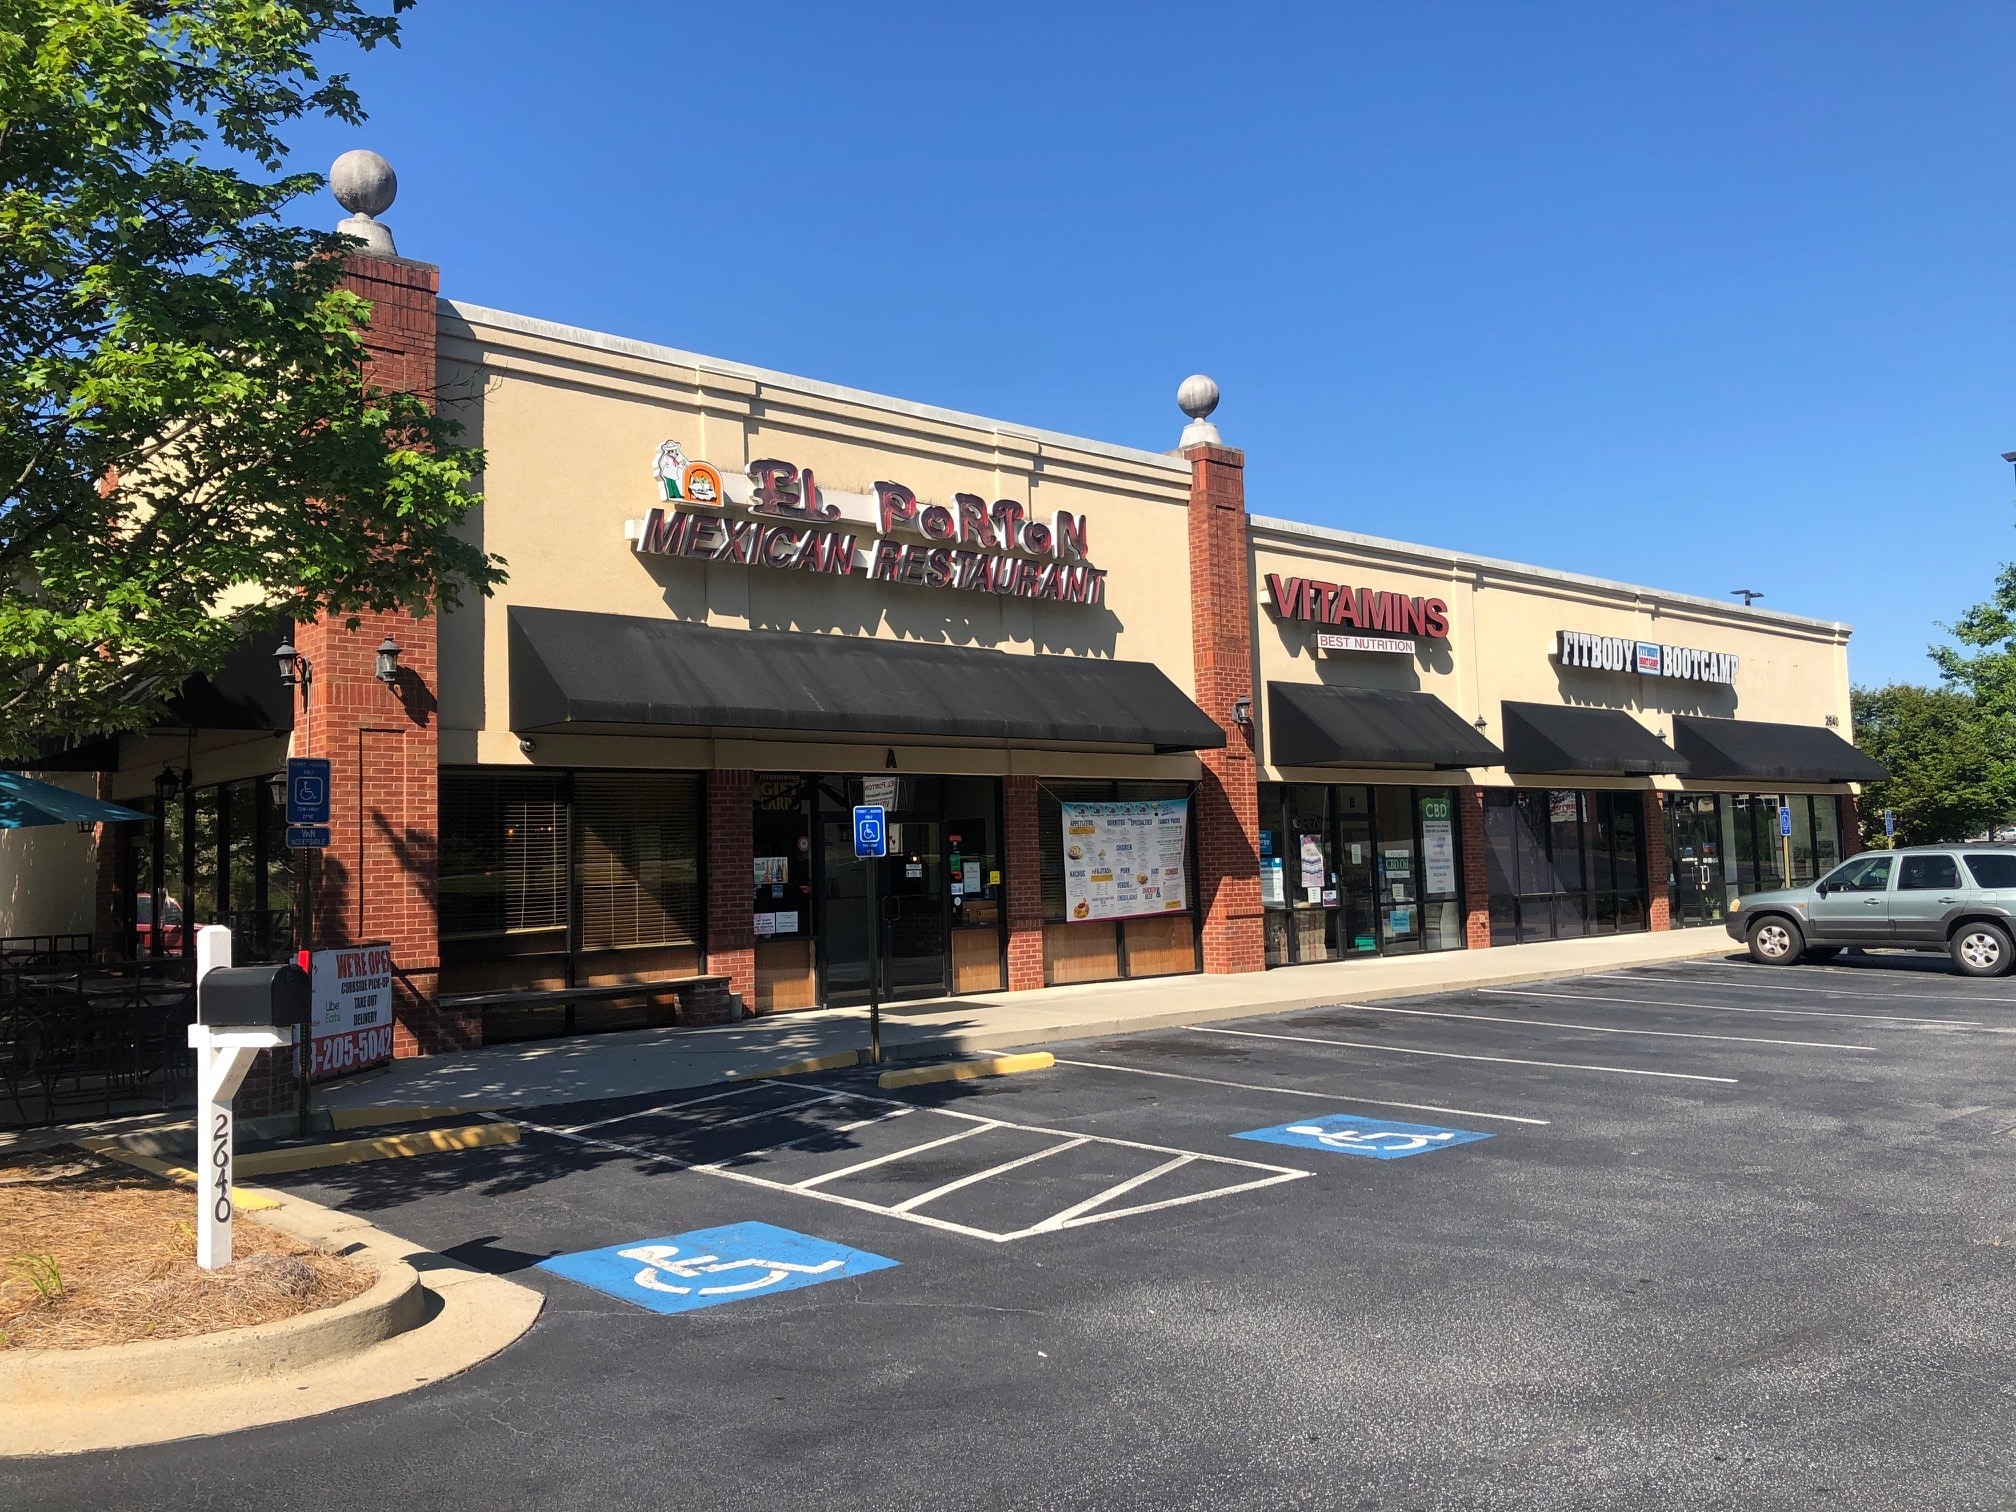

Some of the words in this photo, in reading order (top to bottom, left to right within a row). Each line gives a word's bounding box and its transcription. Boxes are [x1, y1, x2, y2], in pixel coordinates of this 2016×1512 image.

[747, 458, 841, 522] EL
[637, 508, 859, 575] MEXICAN
[867, 538, 1107, 604] RESTAURANT
[1265, 573, 1449, 638] VITAMINS
[1320, 635, 1349, 648] BEST
[1354, 637, 1412, 651] NUTRITION
[1561, 630, 1635, 673] FITBODY
[1662, 645, 1739, 685] BOOTCAMP
[885, 748, 897, 768] A
[1425, 804, 1447, 818] CBD
[301, 829, 316, 838] VAN
[1386, 859, 1399, 869] CBD
[336, 952, 367, 979] WE'RE
[341, 978, 367, 995] CURBSIDE
[368, 976, 389, 991] PICK-UP
[325, 1001, 340, 1011] Uber
[354, 996, 366, 1009] TAKE
[367, 994, 378, 1007] OUT
[325, 1012, 340, 1023] Eats
[353, 1010, 377, 1026] DELIVERY
[213, 1113, 231, 1223] 2640
